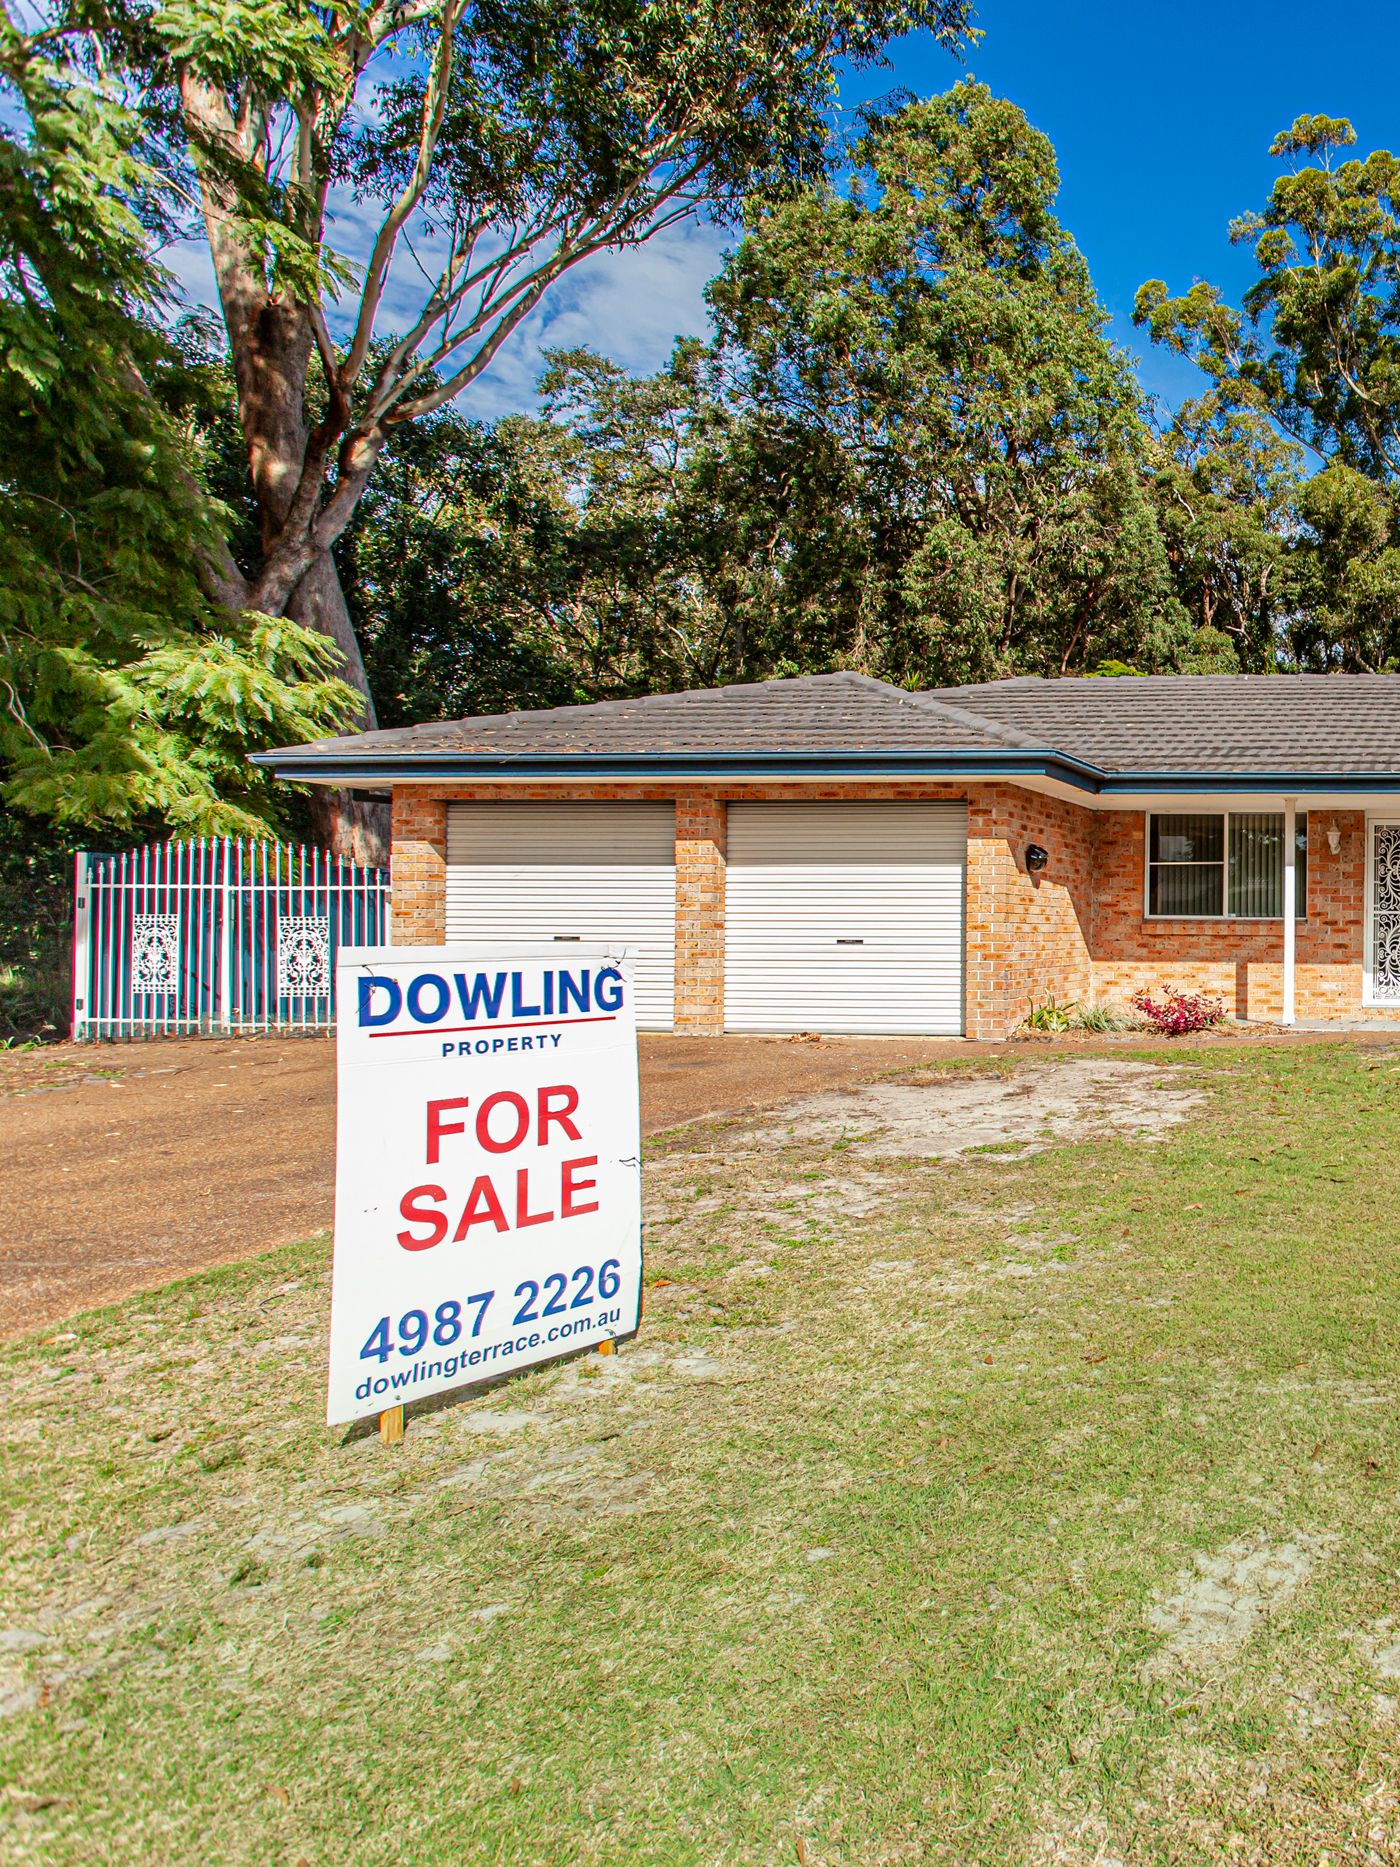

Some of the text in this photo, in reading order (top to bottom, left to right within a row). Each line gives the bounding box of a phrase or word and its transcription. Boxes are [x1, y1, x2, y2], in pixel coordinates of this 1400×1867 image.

[357, 969, 625, 1028] DOWLING
[441, 1034, 563, 1057] PROPERTY
[426, 1084, 582, 1165] FOR
[396, 1155, 599, 1252] SALE
[355, 1307, 621, 1401] dowlingterrace.com.au
[359, 1259, 621, 1363] 4987 2226
